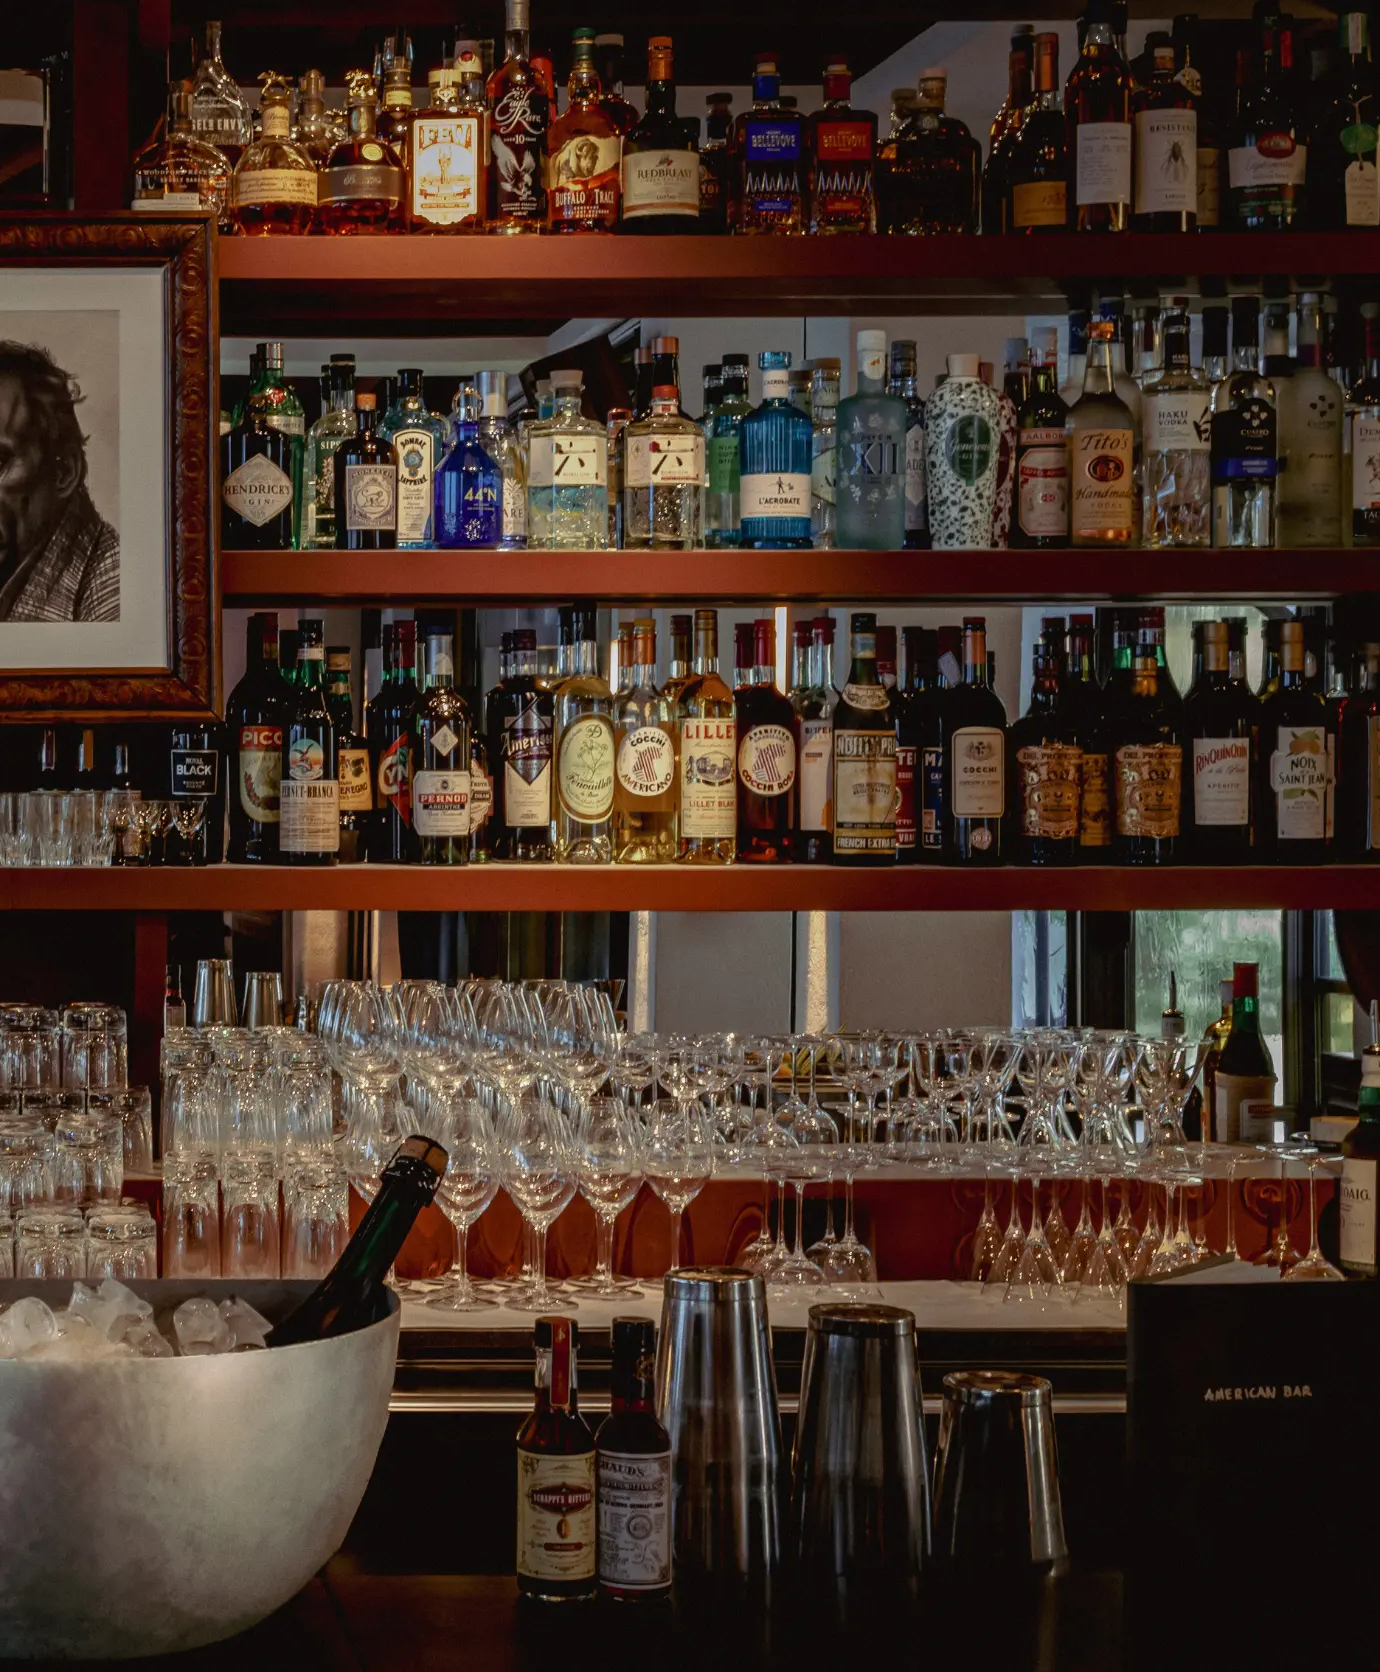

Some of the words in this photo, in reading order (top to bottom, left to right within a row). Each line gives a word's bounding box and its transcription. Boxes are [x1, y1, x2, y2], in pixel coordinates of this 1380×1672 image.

[420, 125, 471, 145] FEW
[515, 133, 525, 144] 10
[751, 134, 796, 148] BELLEVOYE
[554, 191, 586, 205] BUFFALO
[593, 191, 615, 205] TRACE
[1158, 410, 1189, 419] HAKU
[1158, 419, 1189, 427] VODKA
[398, 437, 426, 451] BOMBAY
[1080, 432, 1129, 452] Tito's
[396, 475, 428, 486] SAPPHIRE
[223, 484, 291, 497] HENDRICK'S
[758, 495, 801, 506] L'ACROBATE
[748, 727, 791, 742] APERITIVO
[629, 736, 666, 749] COCCHI
[175, 763, 213, 776] BLACK
[962, 766, 997, 776] COCCHI
[1290, 758, 1317, 774] NOIX
[621, 771, 673, 793] AMERICANO
[1278, 773, 1308, 785] SAINT
[419, 793, 466, 804] PERNOD
[689, 800, 716, 809] LILLET
[836, 837, 867, 850] FRENCH
[1204, 1386, 1275, 1401] AMERICAN
[1282, 1384, 1312, 1398] BAR
[532, 1492, 565, 1505] SCRAPPY'S
